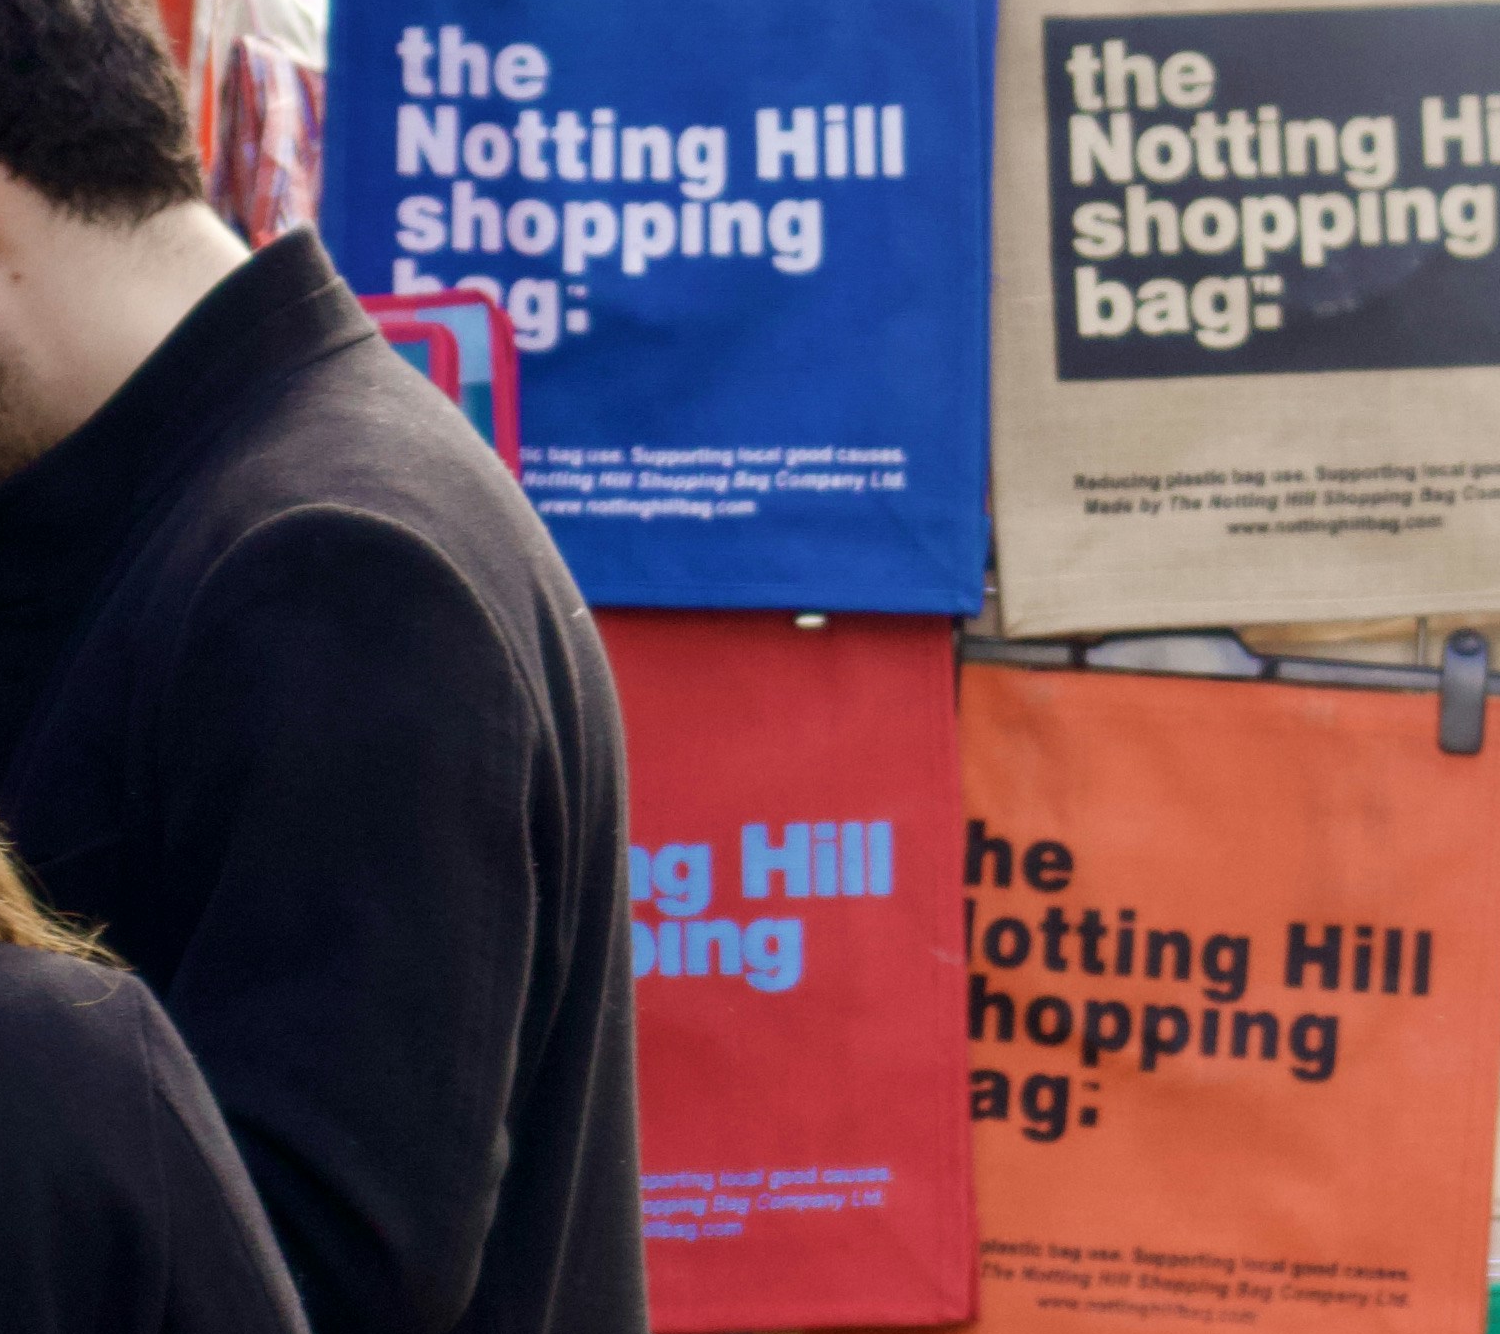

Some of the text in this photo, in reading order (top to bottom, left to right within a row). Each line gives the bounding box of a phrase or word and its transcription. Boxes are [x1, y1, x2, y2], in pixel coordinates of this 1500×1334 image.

[396, 25, 550, 98] the
[1066, 38, 1216, 112] the
[395, 104, 907, 200] Notting Hill
[1070, 106, 1397, 188] Notting
[395, 183, 823, 274] shopping
[1072, 182, 1500, 267] shopping
[631, 446, 734, 467] Supporting
[638, 470, 728, 492] Shopping
[775, 470, 866, 494] Company
[1314, 463, 1417, 485] Supporting
[1209, 491, 1279, 513] Notting
[1322, 487, 1413, 510] Shopping
[741, 820, 894, 899] Hill
[964, 818, 1074, 893] he
[1285, 922, 1434, 998] Hill
[966, 976, 1342, 1084] hopping
